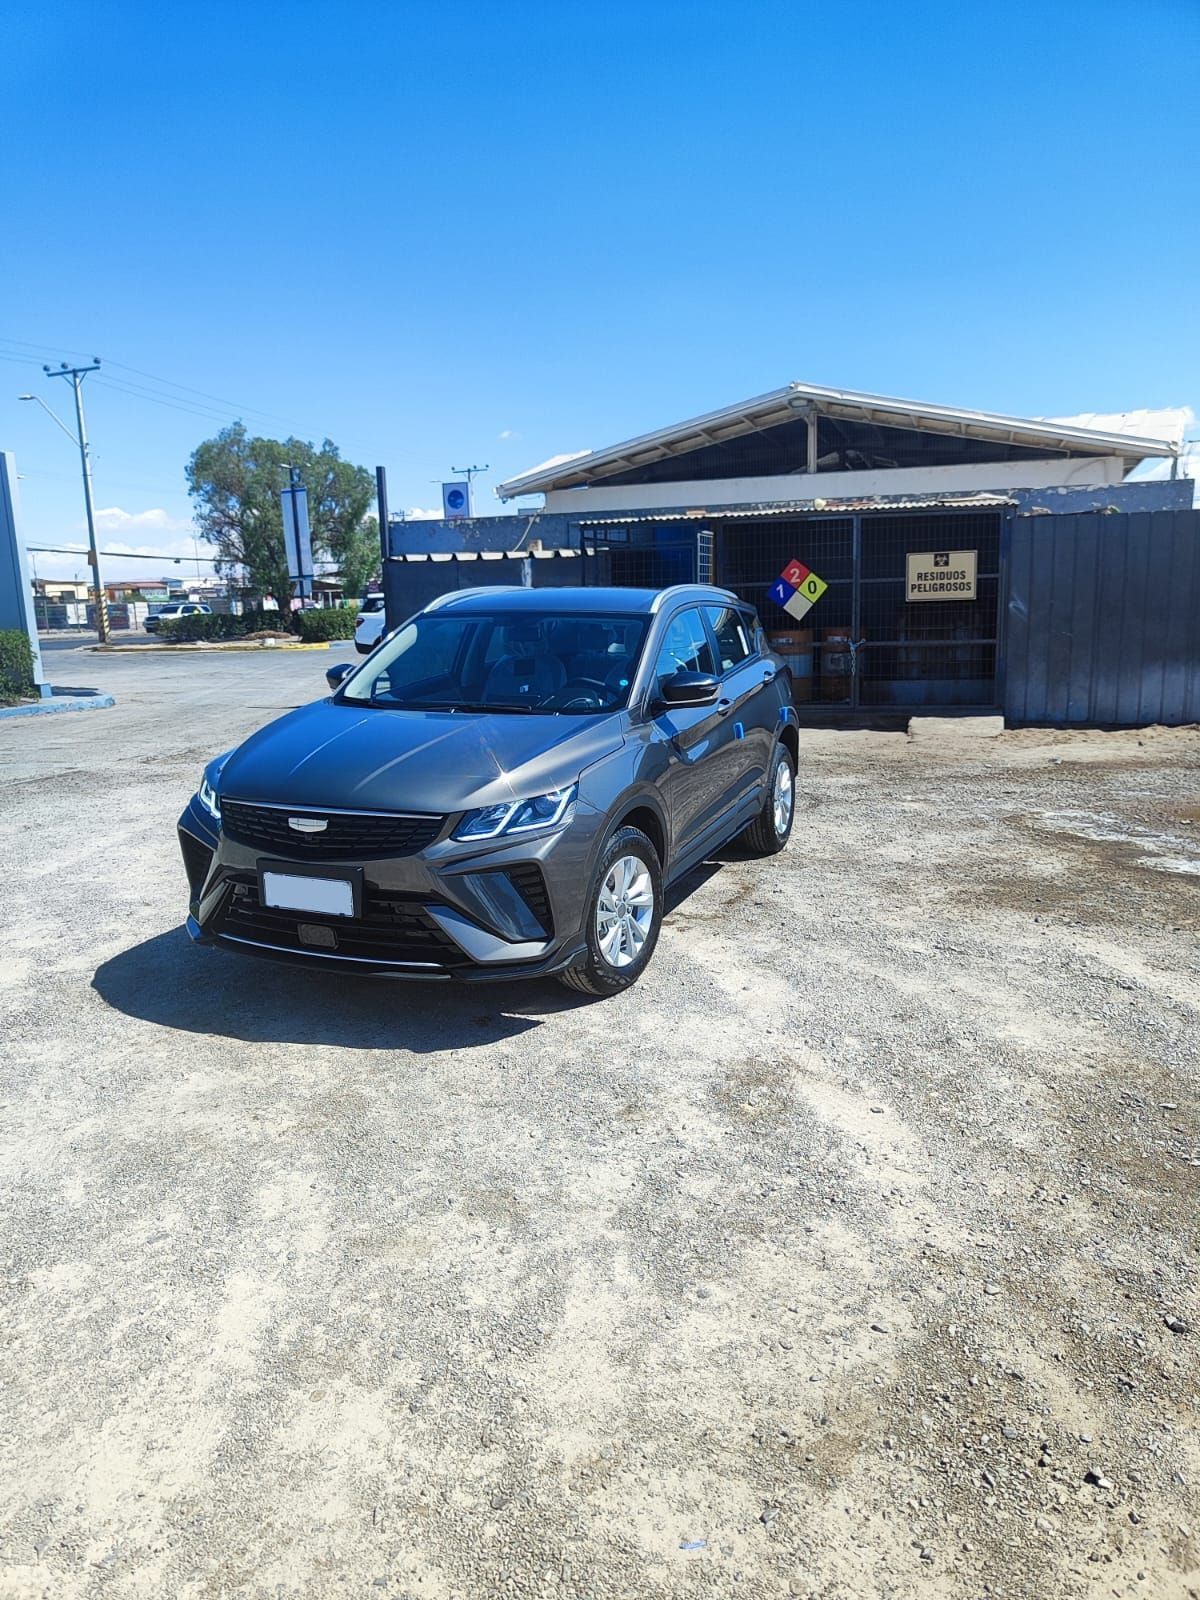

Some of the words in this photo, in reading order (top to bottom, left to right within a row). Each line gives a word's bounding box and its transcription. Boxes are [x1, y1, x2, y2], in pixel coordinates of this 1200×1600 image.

[790, 568, 800, 584] 2
[916, 571, 967, 582] RESIDUOS
[776, 584, 785, 599] 1
[807, 580, 818, 594] 0
[910, 582, 972, 593] PELIGROSOS
